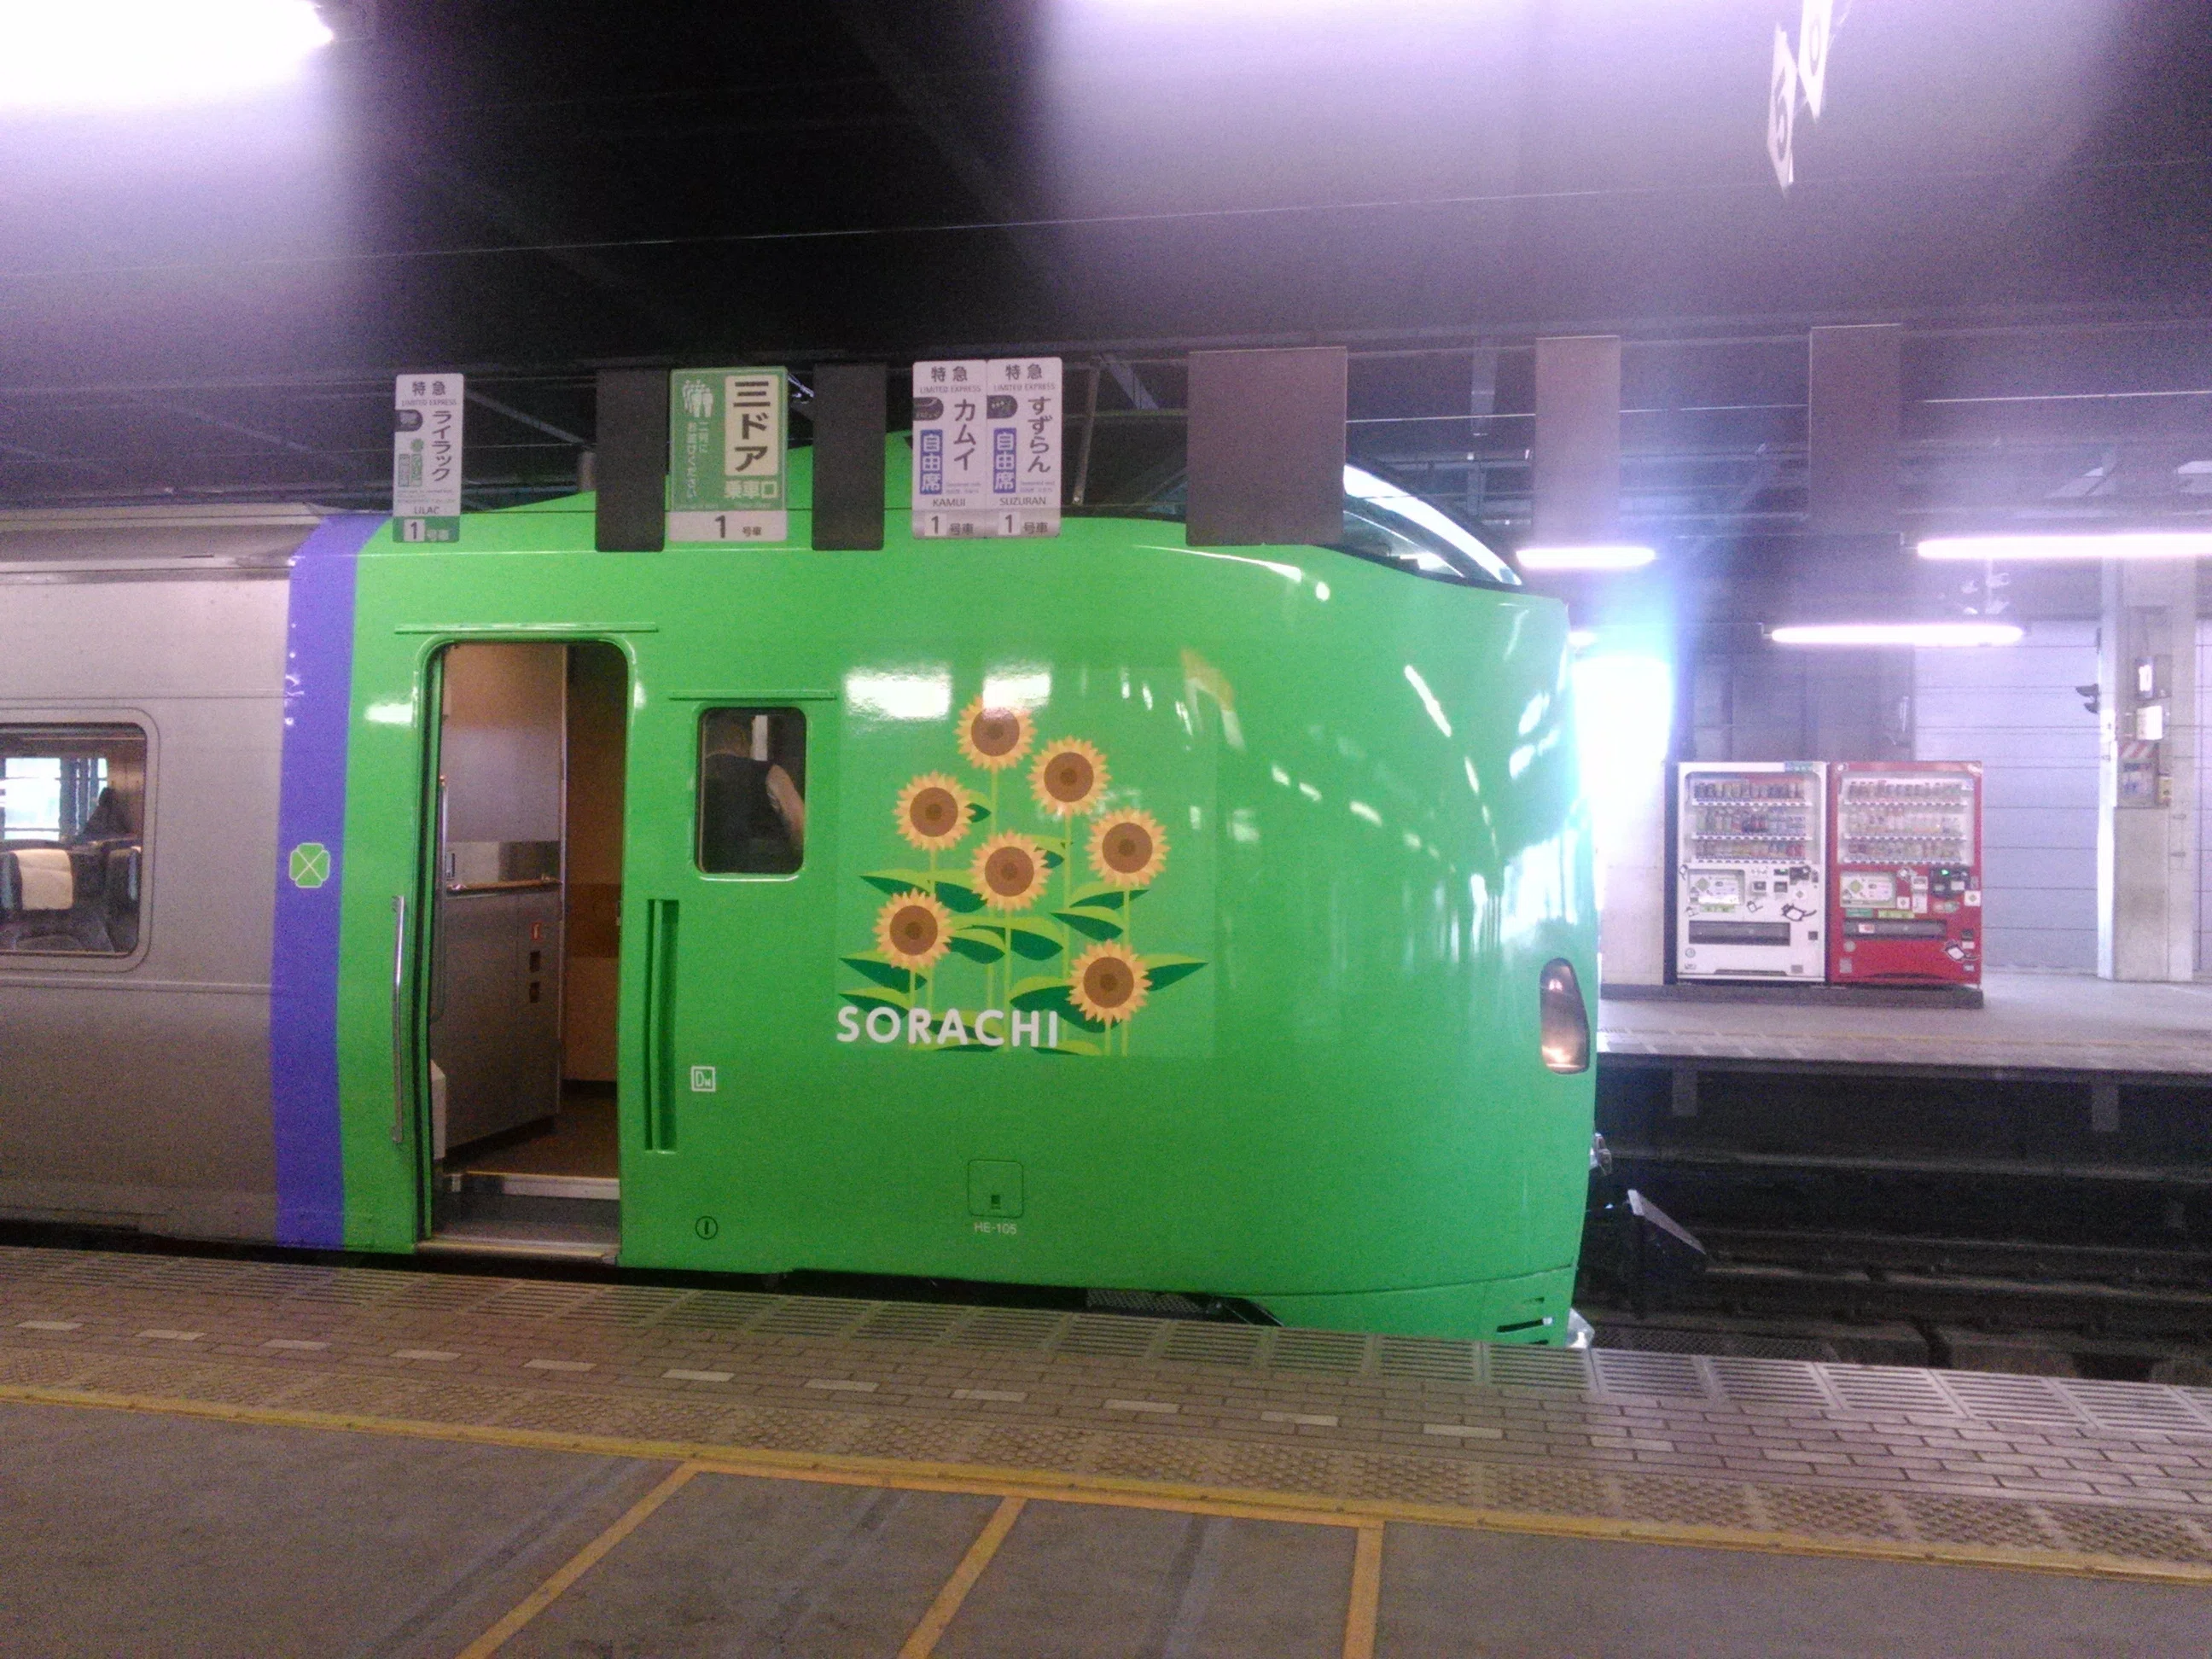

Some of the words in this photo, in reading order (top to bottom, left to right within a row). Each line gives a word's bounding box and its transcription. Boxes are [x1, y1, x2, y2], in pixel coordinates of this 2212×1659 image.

[931, 365, 969, 382] 特急
[1006, 364, 1043, 381] 特急
[412, 381, 445, 396] 特急
[732, 381, 771, 472] 三ドア
[953, 399, 976, 471] カムイ
[1027, 396, 1052, 473] すずらん
[432, 410, 451, 481] ライラック
[921, 434, 941, 492] 自由席
[995, 432, 1016, 491] 自由席
[414, 505, 439, 514] LILAC
[933, 498, 966, 507] KAMUI
[999, 497, 1046, 506] SUZURAN
[410, 521, 417, 539] 1
[715, 515, 725, 538] 1
[742, 526, 762, 538] 号車
[931, 515, 939, 534] 1
[950, 523, 974, 536] 号車
[1004, 515, 1013, 533] 1
[1024, 521, 1048, 535] 号車
[836, 1005, 1058, 1047] SORACHI
[975, 1222, 1017, 1235] HE-105
